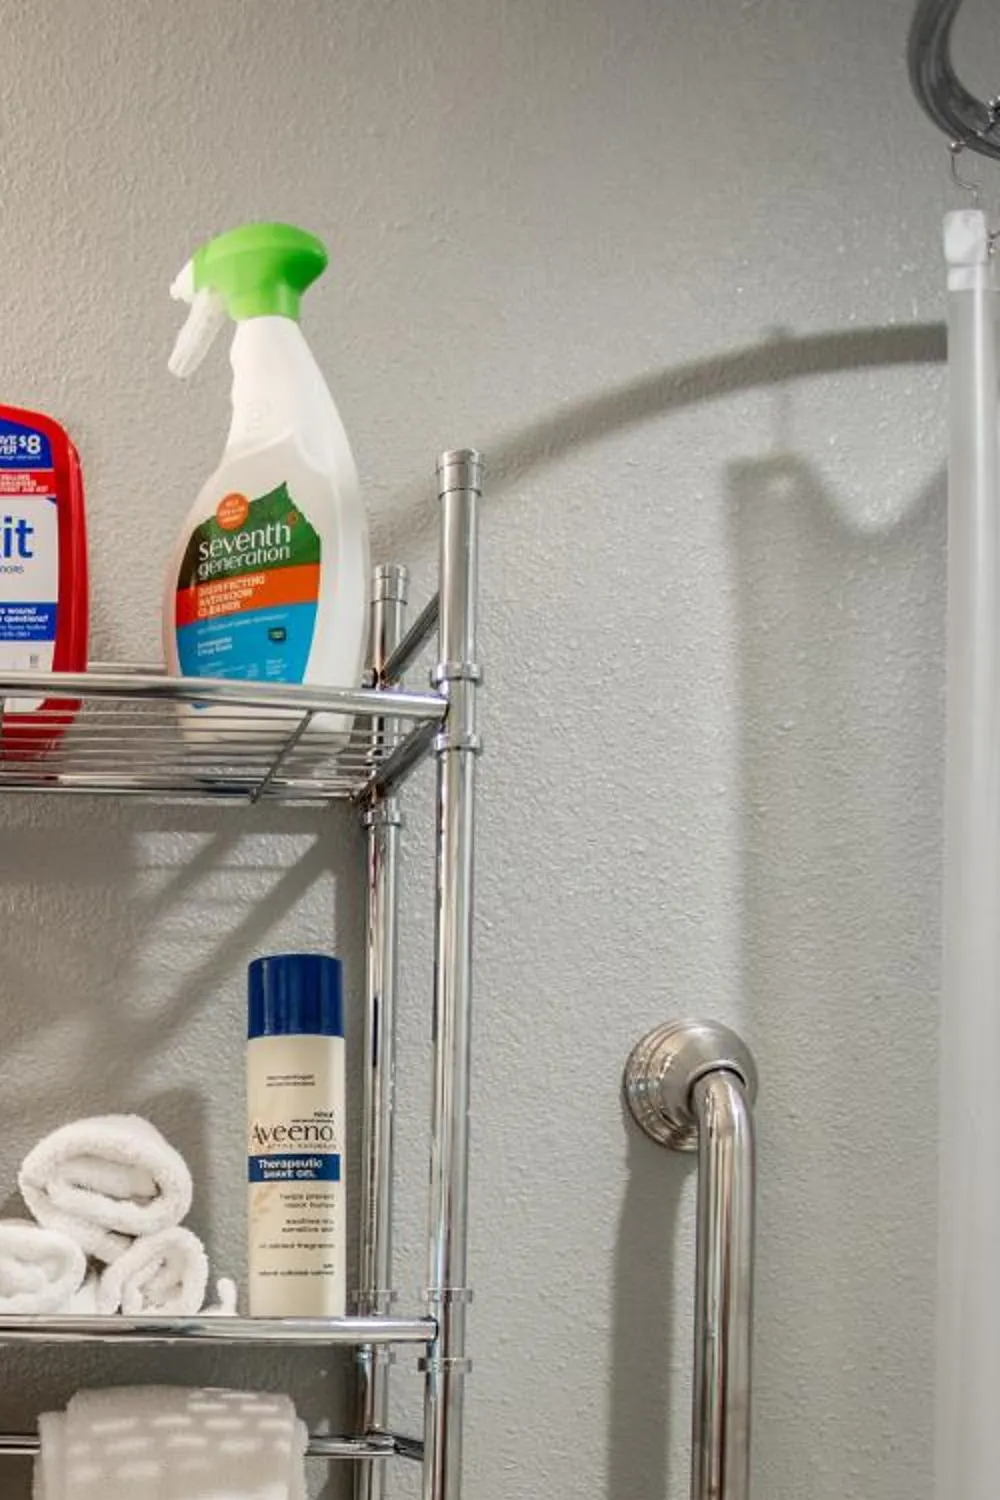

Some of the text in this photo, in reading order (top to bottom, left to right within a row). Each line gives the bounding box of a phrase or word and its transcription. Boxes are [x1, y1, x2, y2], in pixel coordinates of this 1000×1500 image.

[18, 434, 41, 455] $8
[198, 522, 291, 561] seventh
[197, 546, 291, 579] generation
[252, 1122, 333, 1145] Aveeno
[259, 1159, 323, 1170] Therapeutic
